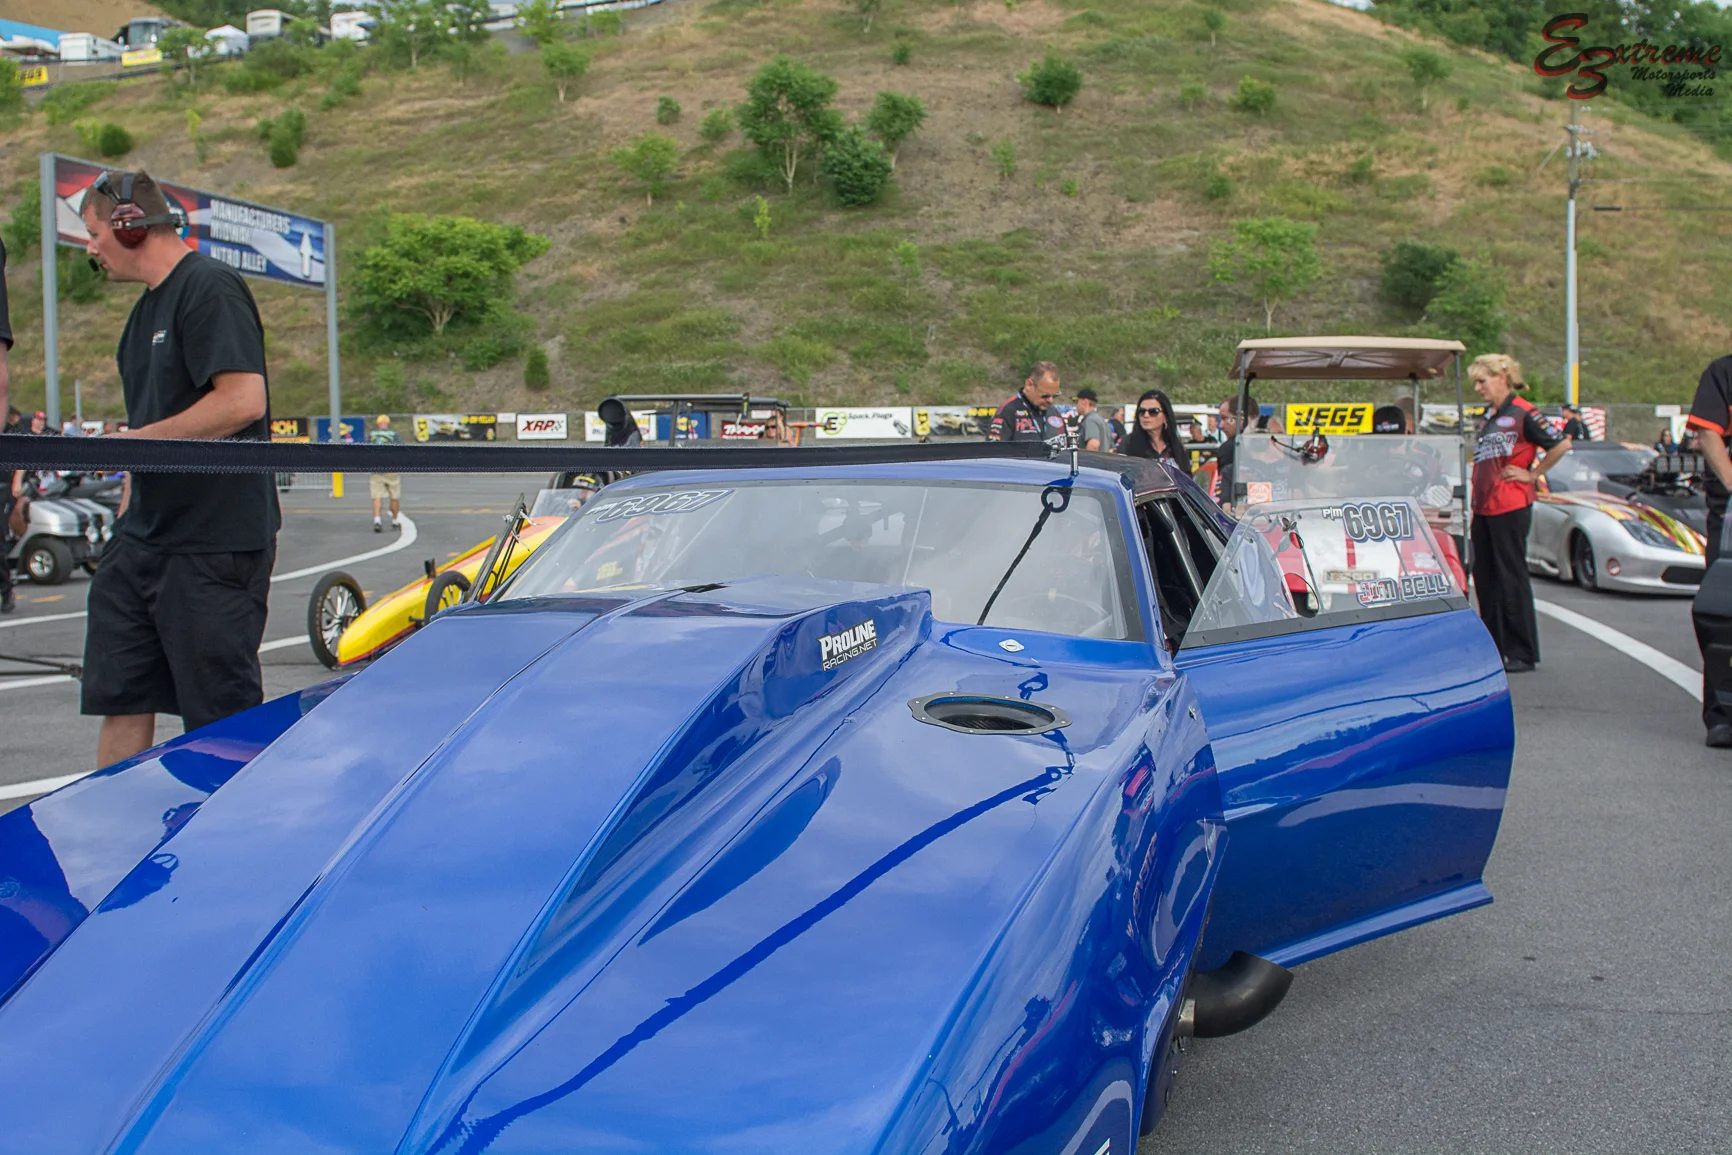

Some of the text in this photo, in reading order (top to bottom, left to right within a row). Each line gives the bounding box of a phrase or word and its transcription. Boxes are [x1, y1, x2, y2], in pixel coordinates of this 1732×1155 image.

[210, 245, 267, 273] NITRO ALLEY
[522, 420, 556, 432] XRP
[1294, 407, 1366, 426] JEGS
[595, 488, 735, 525] 6967
[1341, 502, 1415, 543] 6967
[1400, 573, 1451, 602] BELL
[823, 638, 877, 672] RACING.NET
